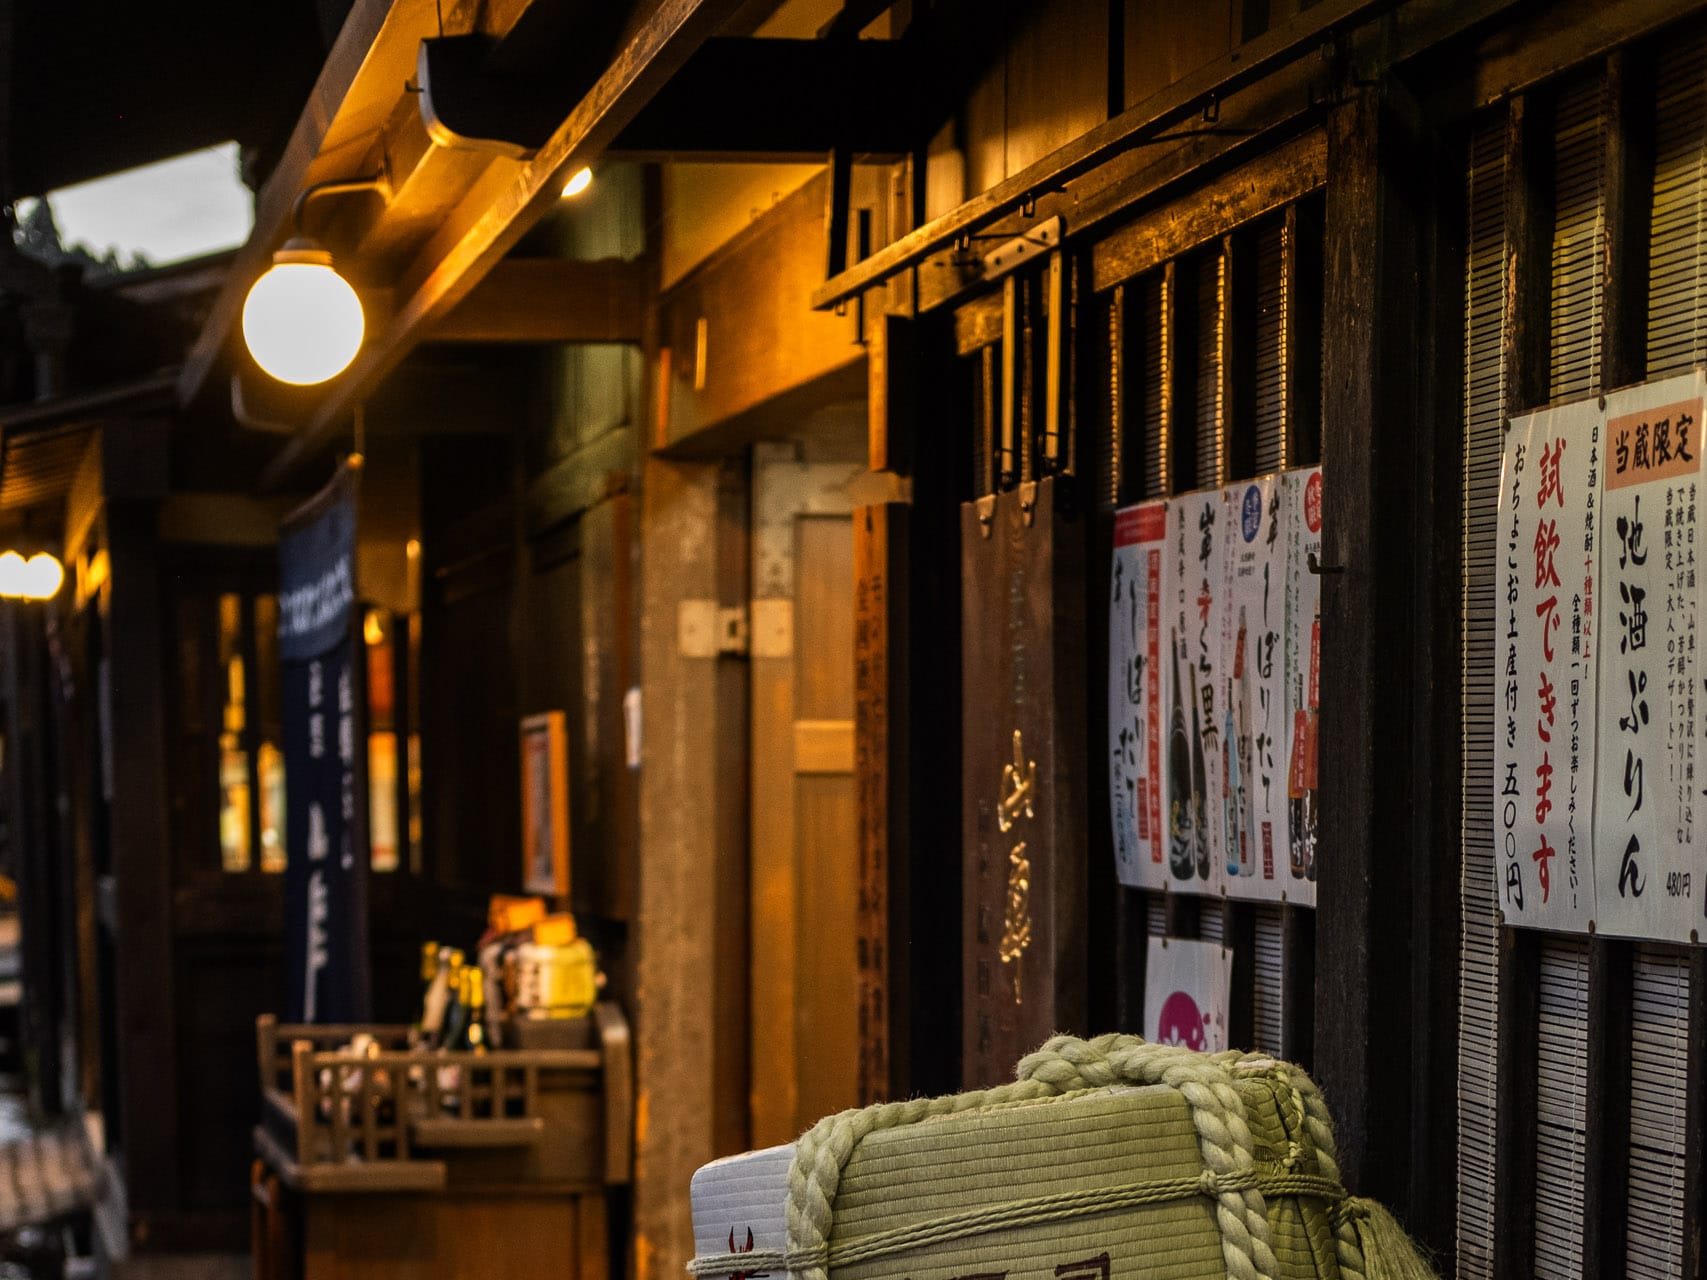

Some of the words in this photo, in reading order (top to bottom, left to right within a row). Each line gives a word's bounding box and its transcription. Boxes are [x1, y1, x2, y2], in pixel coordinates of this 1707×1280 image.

[1615, 413, 1693, 474] 当蔵限定
[1532, 437, 1567, 904] 試飲できます
[1617, 494, 1650, 898] 地酒ぷりん
[1666, 871, 1691, 898] 480円
